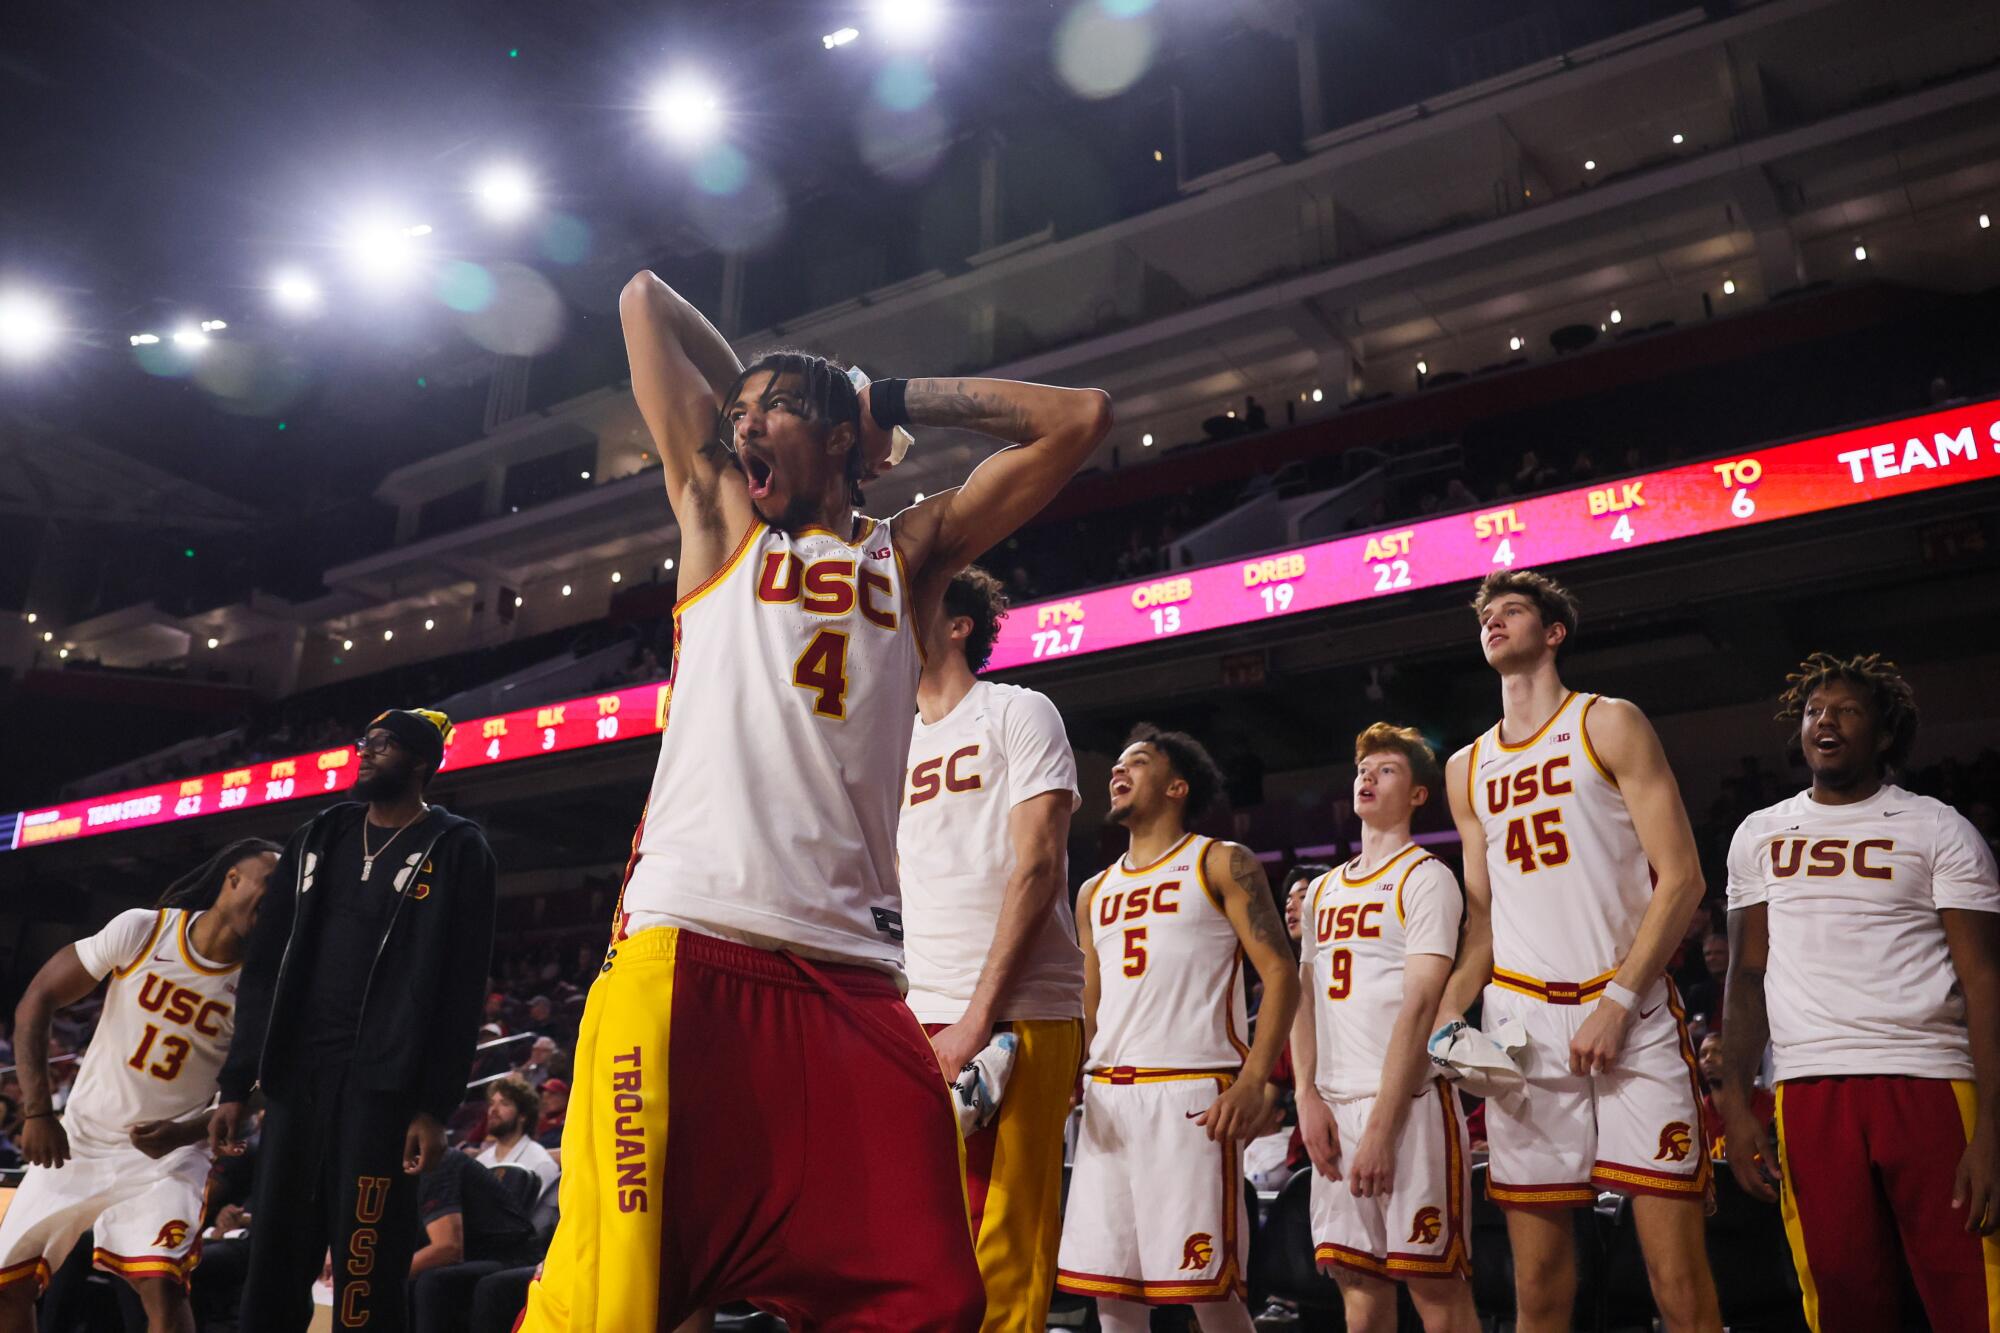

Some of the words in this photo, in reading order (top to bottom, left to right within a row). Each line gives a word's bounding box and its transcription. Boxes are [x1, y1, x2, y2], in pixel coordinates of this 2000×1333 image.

[1837, 426, 1978, 484] TEAM
[1714, 458, 1762, 488] TO
[1587, 482, 1645, 516] BLK
[1731, 488, 1756, 519] 6
[1474, 508, 1526, 539] STL
[1610, 514, 1635, 543] 4
[1363, 530, 1414, 562] AST
[1492, 538, 1515, 566] 4
[1243, 554, 1306, 587] DREB
[1373, 560, 1412, 591] 22
[756, 551, 898, 631] USC
[1131, 578, 1192, 609] OREB
[1260, 583, 1294, 613] 19
[1037, 600, 1085, 629] FT%
[1150, 605, 1181, 634] 13
[1031, 625, 1084, 658] 72.7
[792, 628, 849, 720] 4
[537, 706, 566, 729] BLK
[596, 695, 621, 716] TO
[483, 718, 508, 738] STL
[542, 728, 556, 750] 3
[596, 716, 619, 740] 10
[486, 739, 500, 760] 4
[324, 770, 336, 790] 3
[898, 744, 983, 807] SC
[1486, 754, 1574, 816] USC
[1505, 807, 1570, 875] 45
[1770, 838, 1894, 880] USC
[1100, 880, 1182, 927] USC
[1317, 902, 1384, 943] USC
[1123, 926, 1148, 979] 5
[1328, 947, 1353, 1001] 9
[138, 972, 231, 1037] USC
[128, 1022, 191, 1082] 13
[613, 1046, 648, 1213] TROJANS
